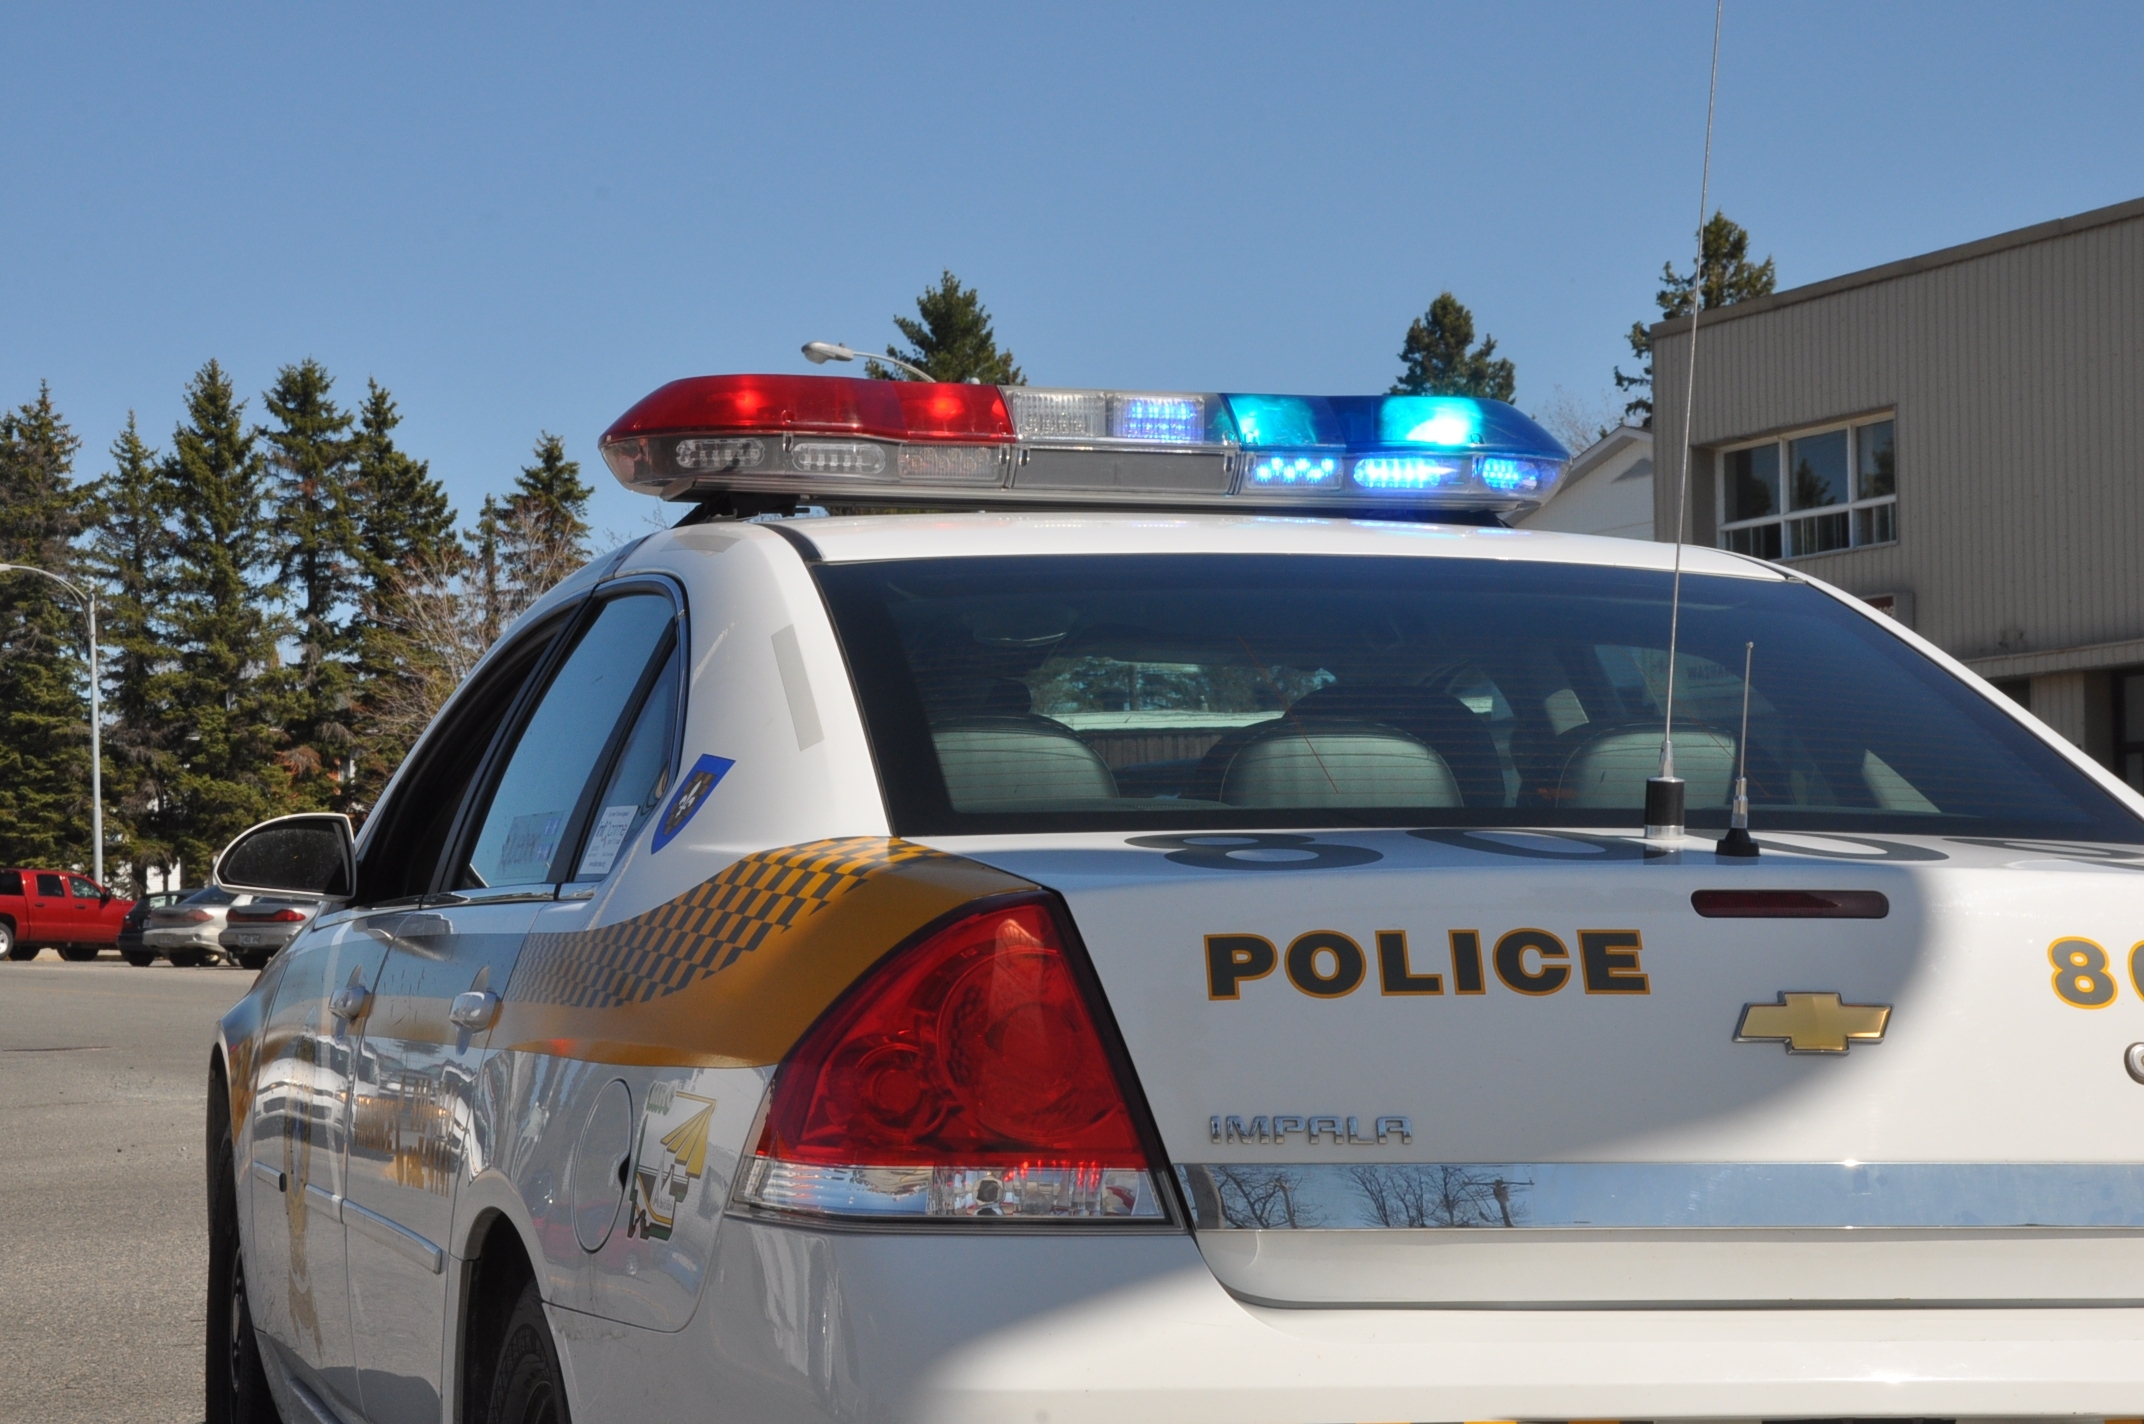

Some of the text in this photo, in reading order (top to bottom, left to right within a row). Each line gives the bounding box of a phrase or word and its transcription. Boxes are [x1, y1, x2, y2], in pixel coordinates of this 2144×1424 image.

[1204, 928, 1651, 1001] POLICE
[2047, 935, 2144, 1010] 8
[1209, 1114, 1413, 1145] IMPALA
